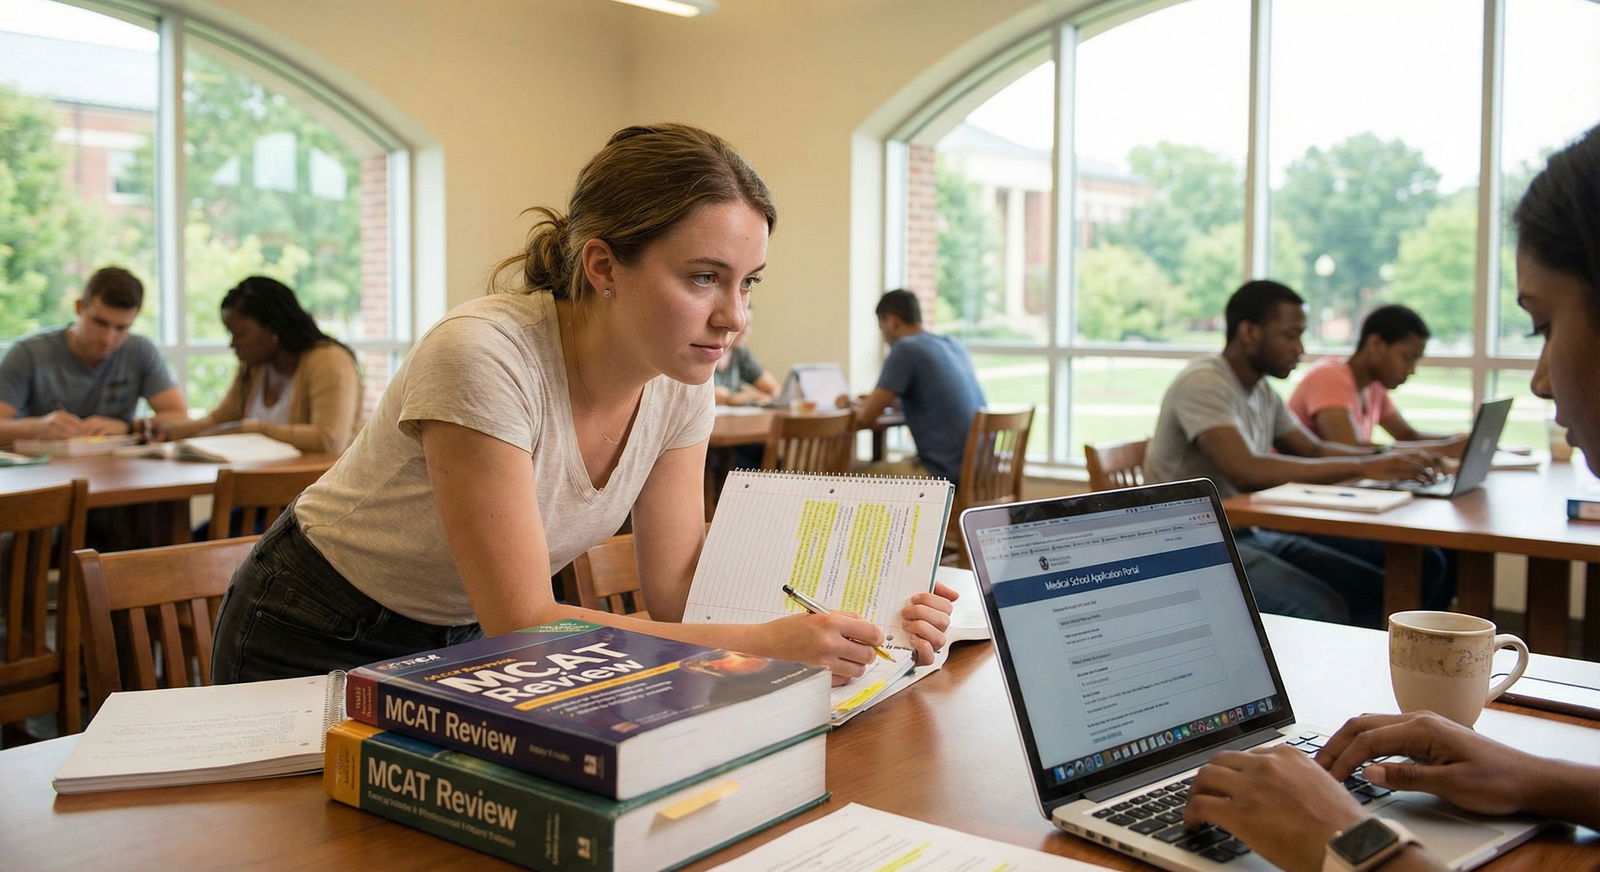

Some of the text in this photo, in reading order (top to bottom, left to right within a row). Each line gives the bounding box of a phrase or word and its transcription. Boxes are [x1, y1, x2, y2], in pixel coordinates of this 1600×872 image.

[1045, 565, 1140, 590] Medical School Application Portal
[437, 642, 629, 693] MCAT
[482, 659, 644, 703] Review
[385, 694, 440, 733] MCAT
[445, 711, 517, 755] Review
[368, 756, 430, 801] MCAT
[436, 778, 518, 831] Review
